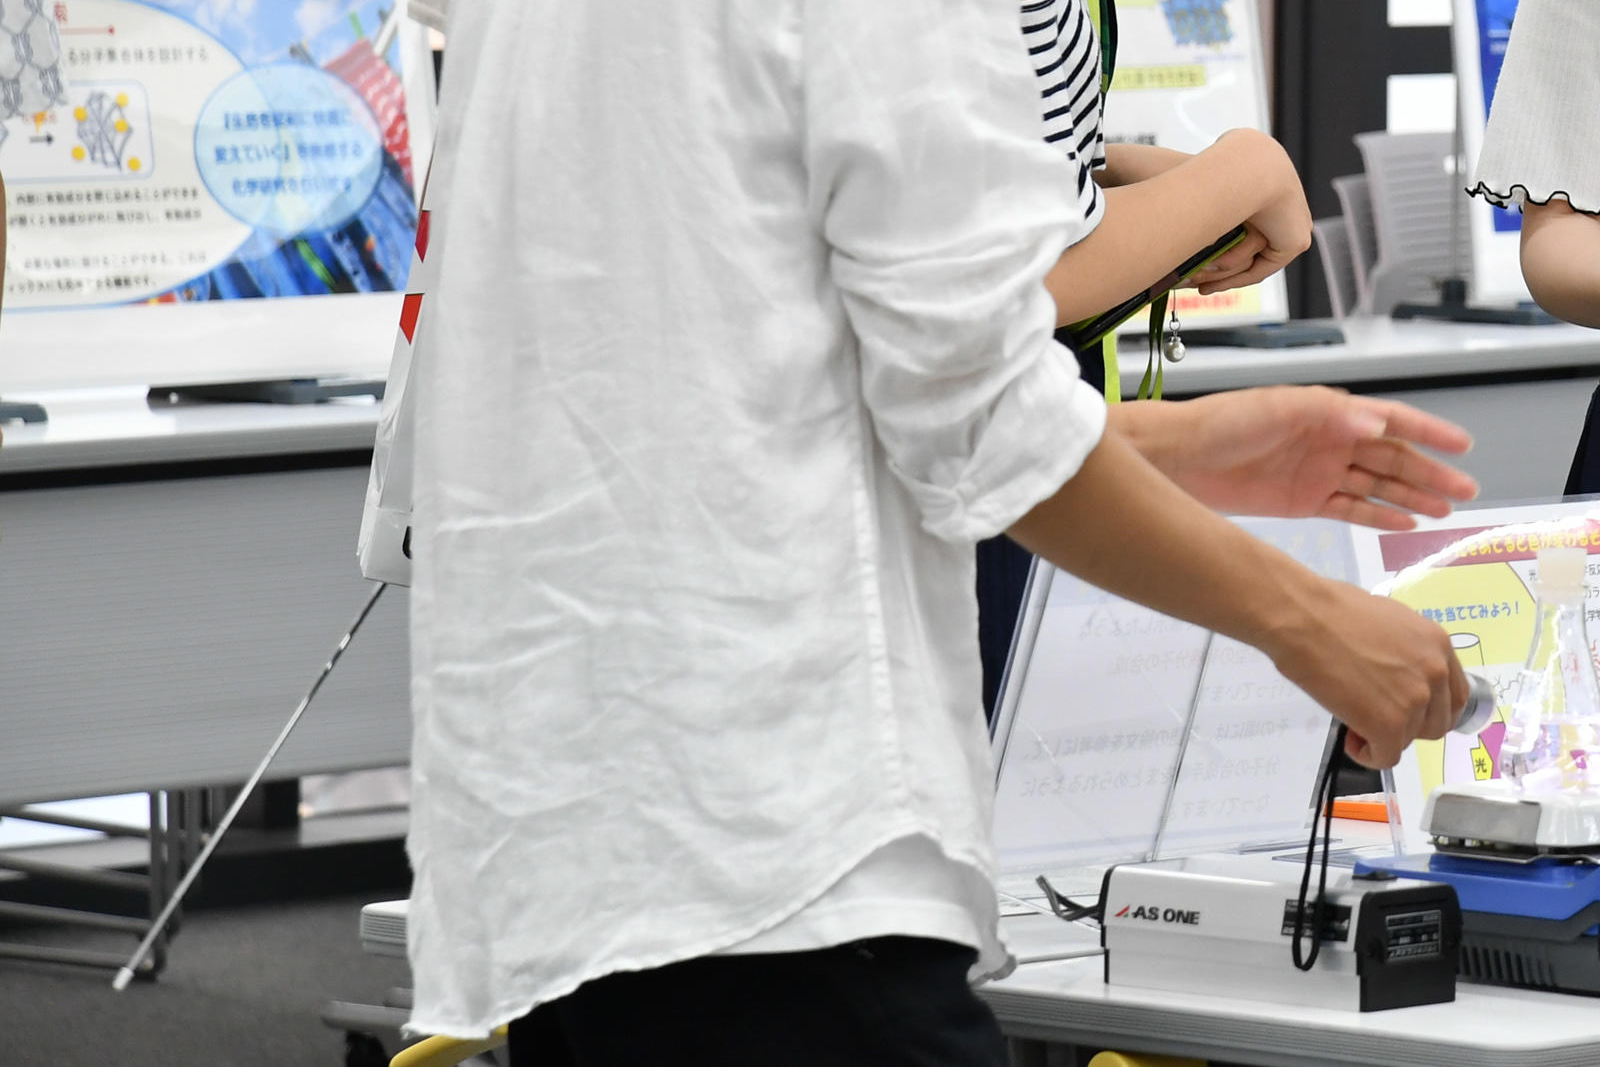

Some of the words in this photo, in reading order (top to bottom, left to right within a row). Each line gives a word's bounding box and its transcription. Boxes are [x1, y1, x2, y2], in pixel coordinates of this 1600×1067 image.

[1416, 600, 1520, 623] 線を当ててみよう！
[1474, 758, 1488, 774] 光
[1132, 905, 1160, 921] AS
[1163, 908, 1200, 925] ONE
